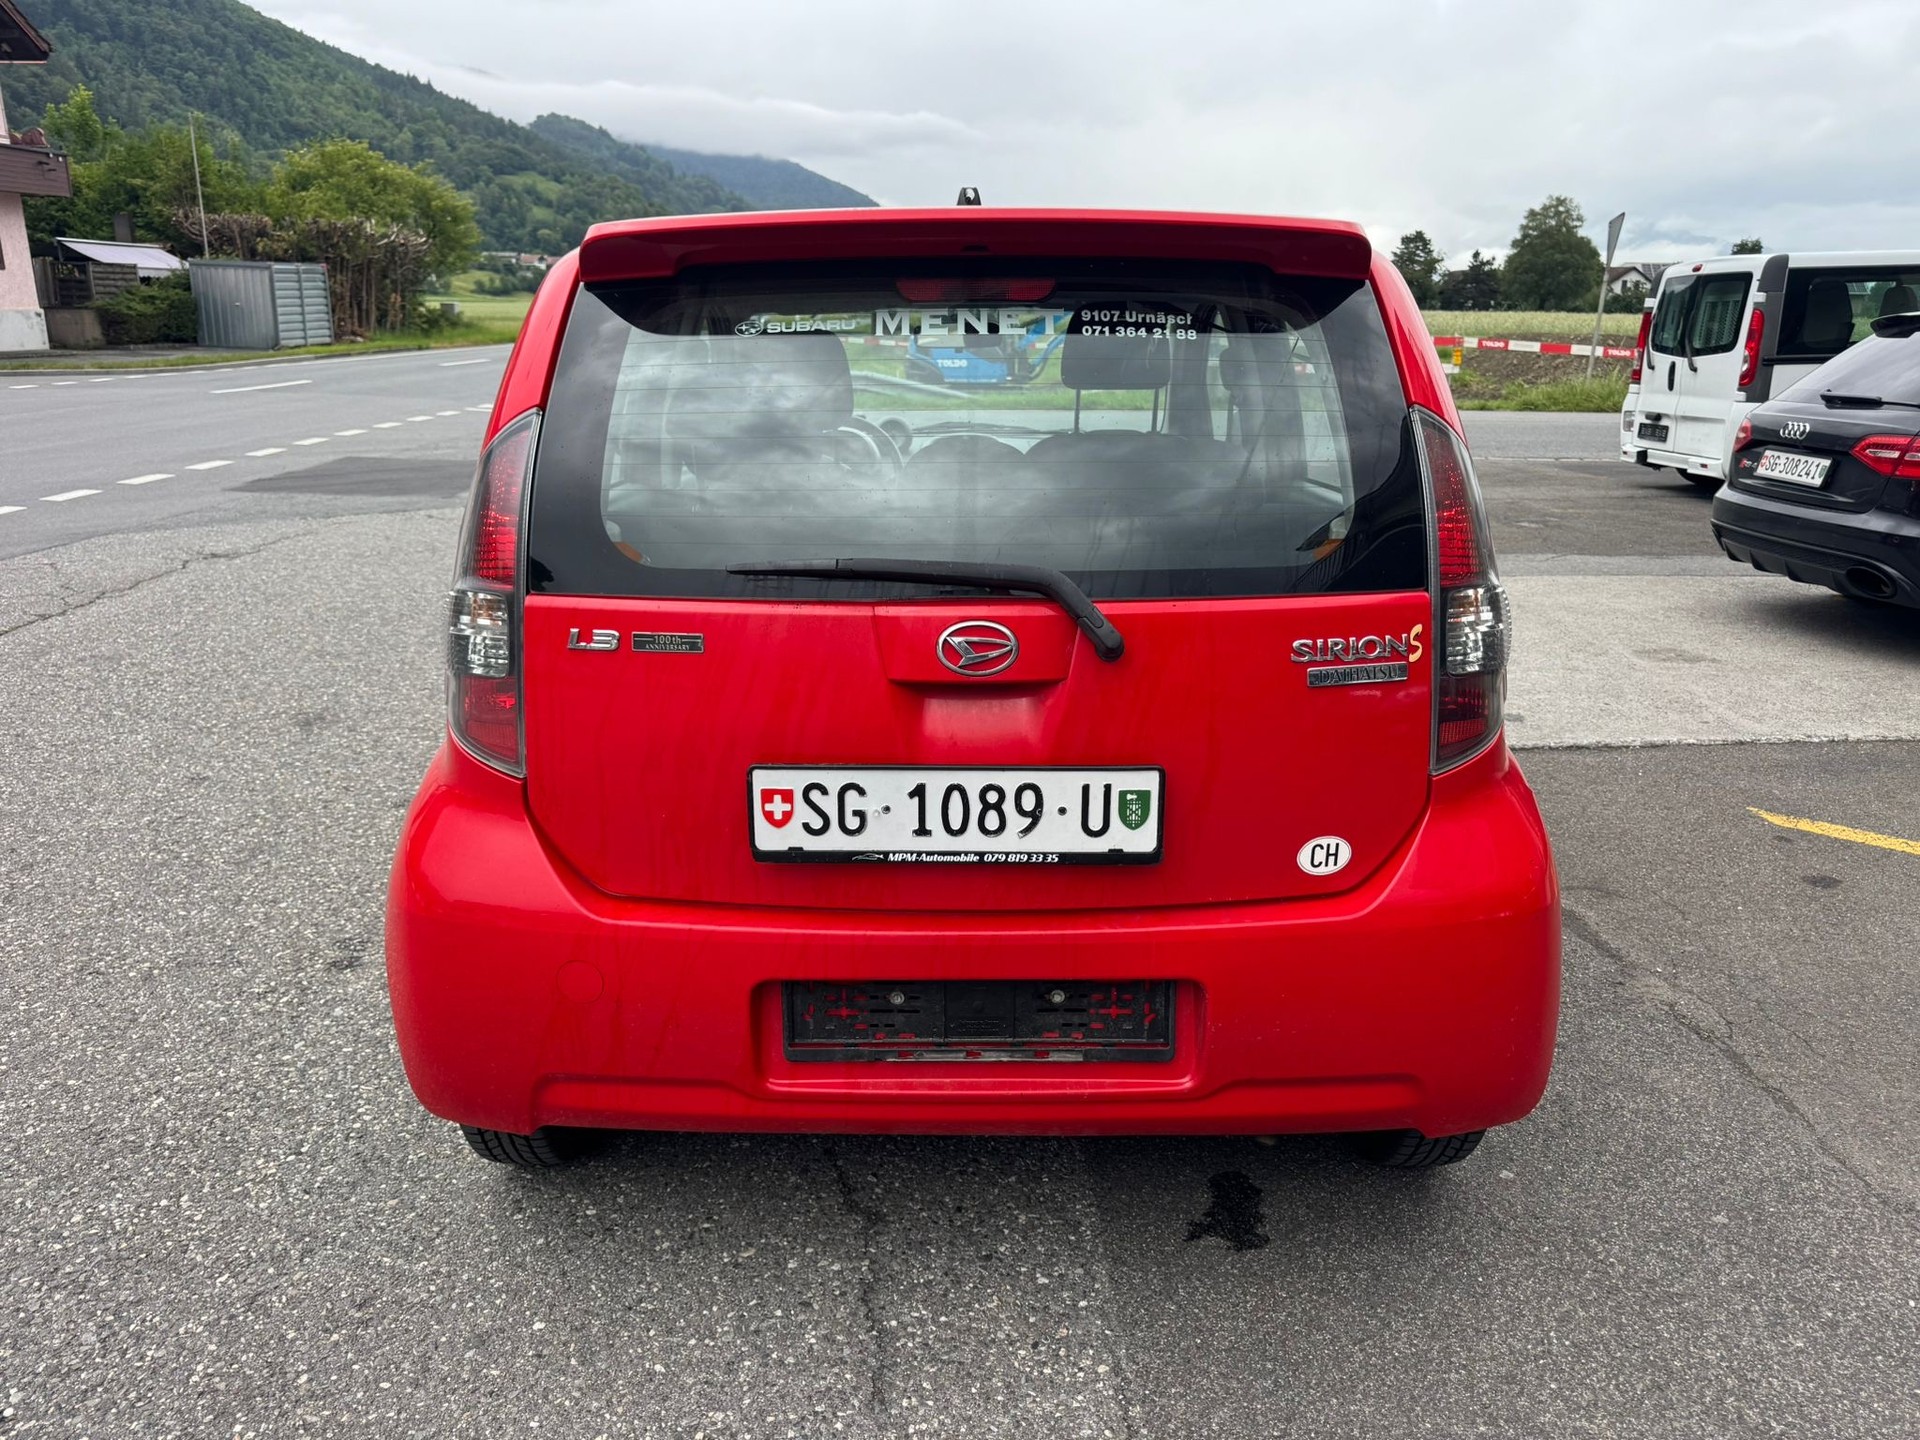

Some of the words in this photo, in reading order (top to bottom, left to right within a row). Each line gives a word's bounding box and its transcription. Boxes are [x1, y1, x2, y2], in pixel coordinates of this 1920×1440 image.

[875, 307, 1065, 336] MENET
[1081, 309, 1120, 322] 9107
[767, 319, 856, 334] SUBARU
[1082, 325, 1110, 337] 071
[1115, 326, 1147, 338] 364
[1152, 328, 1170, 339] 21
[1176, 329, 1197, 340] 88
[1481, 339, 1505, 348] TOLDO
[1608, 349, 1631, 357] TOLDO
[937, 359, 968, 368] TOLDO
[654, 635, 681, 644] 100th
[645, 643, 690, 651] ANNIVERSARY
[1318, 664, 1400, 685] DAIHATSU
[801, 781, 869, 838] SG
[906, 781, 1044, 838] 1089
[1080, 782, 1112, 838] U
[887, 853, 980, 863] MPM-Automobile
[983, 853, 1006, 862] 079
[1007, 854, 1028, 863] 819
[1029, 854, 1043, 863] 33
[1044, 854, 1059, 863] 35
[1310, 842, 1340, 868] CH
